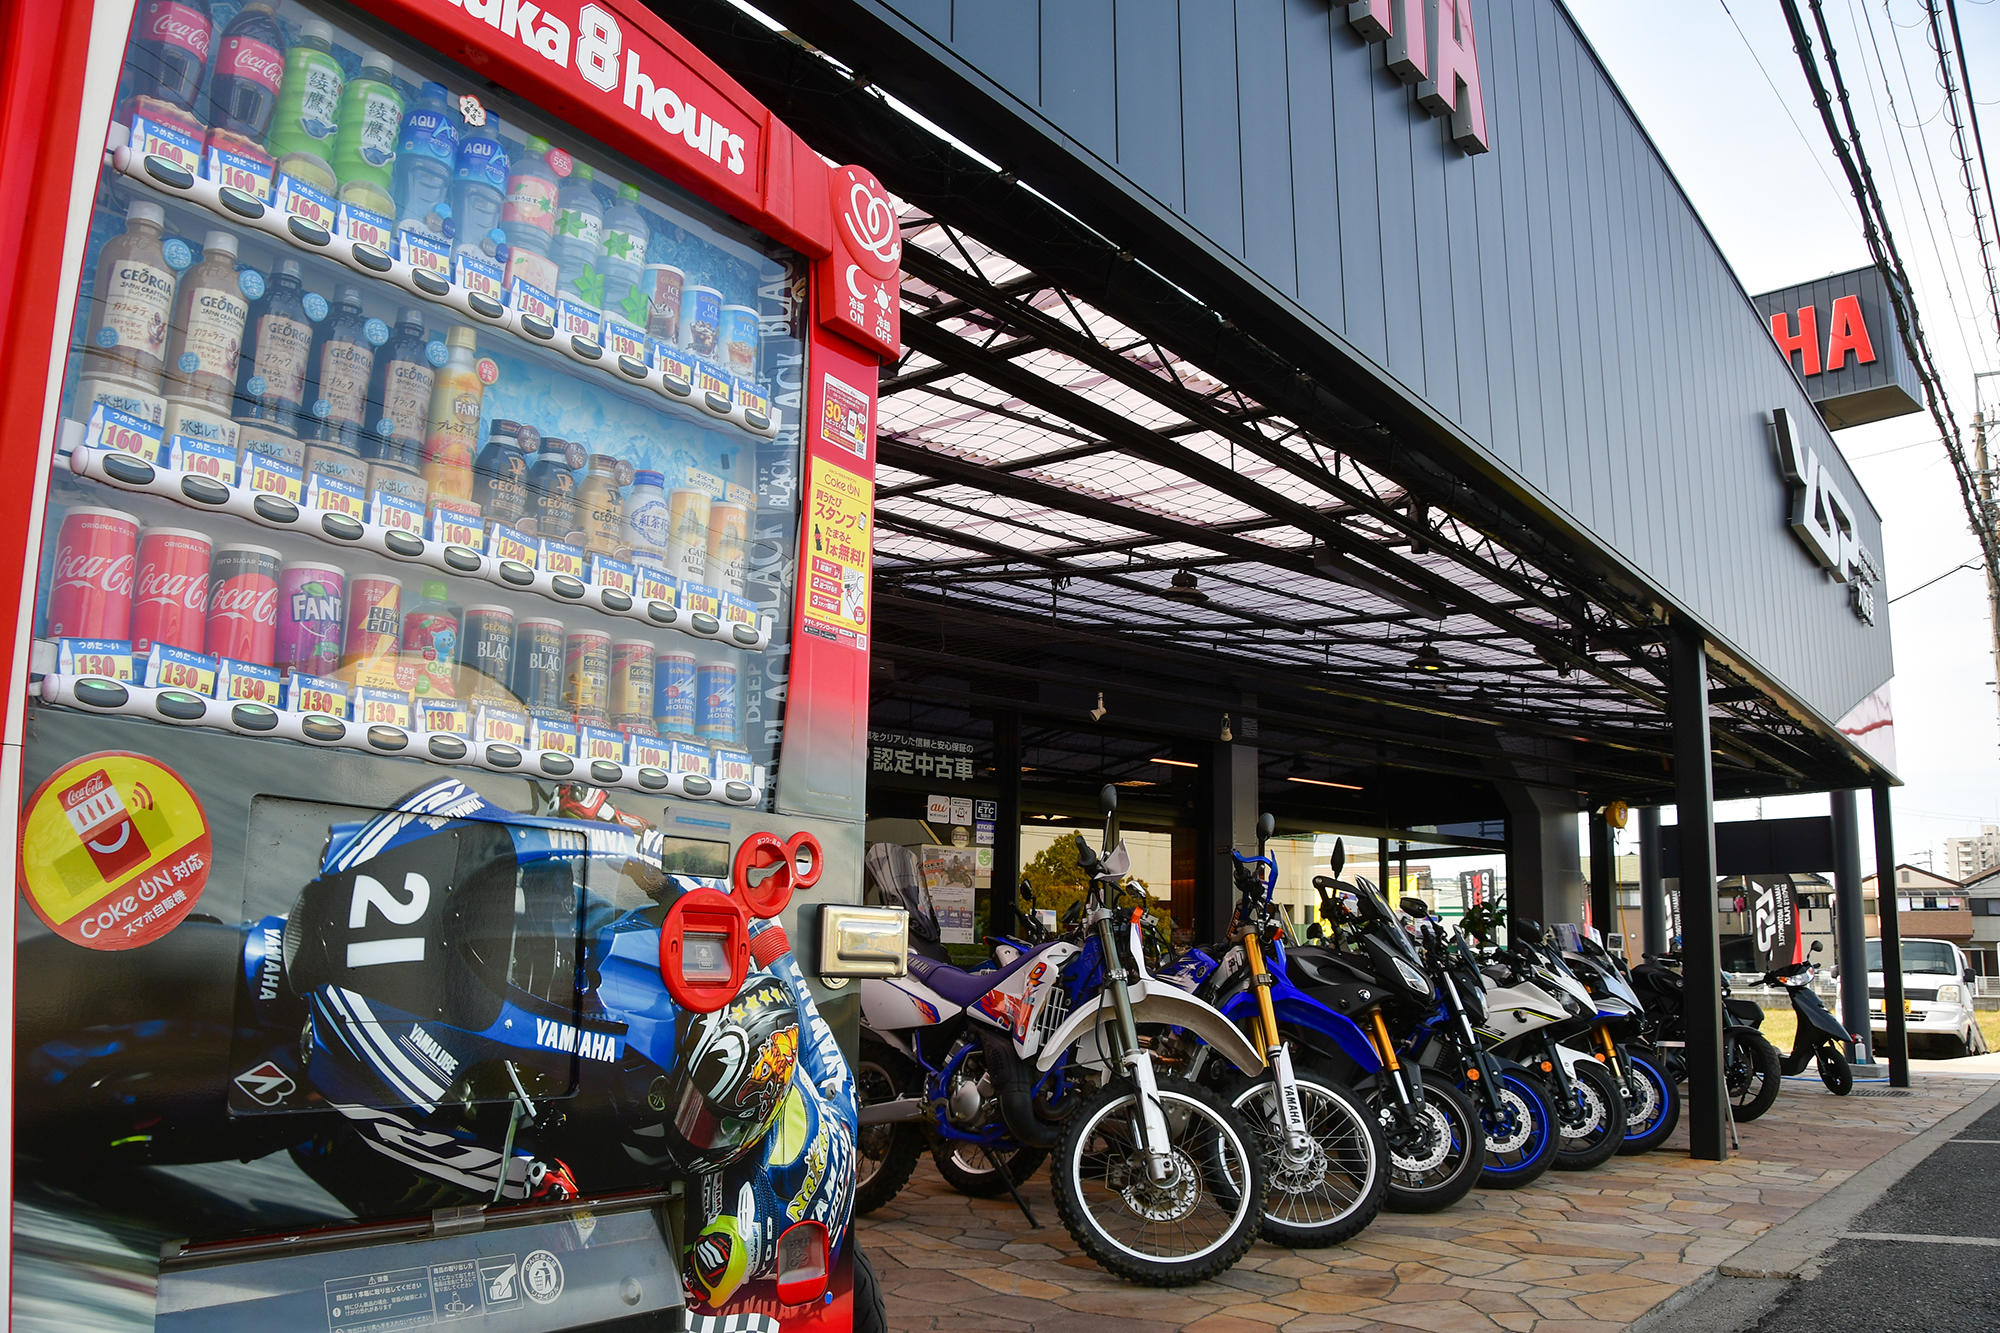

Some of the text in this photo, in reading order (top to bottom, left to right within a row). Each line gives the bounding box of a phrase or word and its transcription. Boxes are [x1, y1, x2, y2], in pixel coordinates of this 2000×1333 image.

[304, 72, 329, 114] 綾鷹
[576, 3, 622, 93] 8
[623, 49, 745, 175] hours
[363, 101, 388, 141] 綾鷹
[849, 296, 864, 314] 冷却
[850, 311, 864, 327] ON
[875, 327, 892, 344] OFF
[876, 314, 891, 331] 冷却
[824, 473, 847, 492] Coke
[816, 489, 842, 508] 買うたび
[815, 501, 857, 529] スタンプ
[825, 526, 851, 544] たまると
[56, 545, 136, 601] Coca-Co
[137, 563, 209, 615] Coca-Co
[210, 579, 278, 627] Coca-Co
[291, 594, 342, 622] FANT
[368, 606, 399, 620] REA
[477, 641, 511, 661] BLAC
[530, 653, 561, 671] BLAC
[873, 747, 974, 781] 認定中古車
[68, 775, 104, 805] Coca-Cola
[930, 803, 947, 813] au
[978, 806, 994, 815] ETC
[80, 853, 205, 939] Coke ON 対応
[123, 889, 187, 936] スマホ自販機
[347, 872, 431, 968] 21
[259, 928, 281, 1001] YAMAHA
[409, 1023, 459, 1077] YAMALUBE
[536, 1018, 616, 1063] YAMAHA
[1284, 1085, 1301, 1125] YAMAHA
